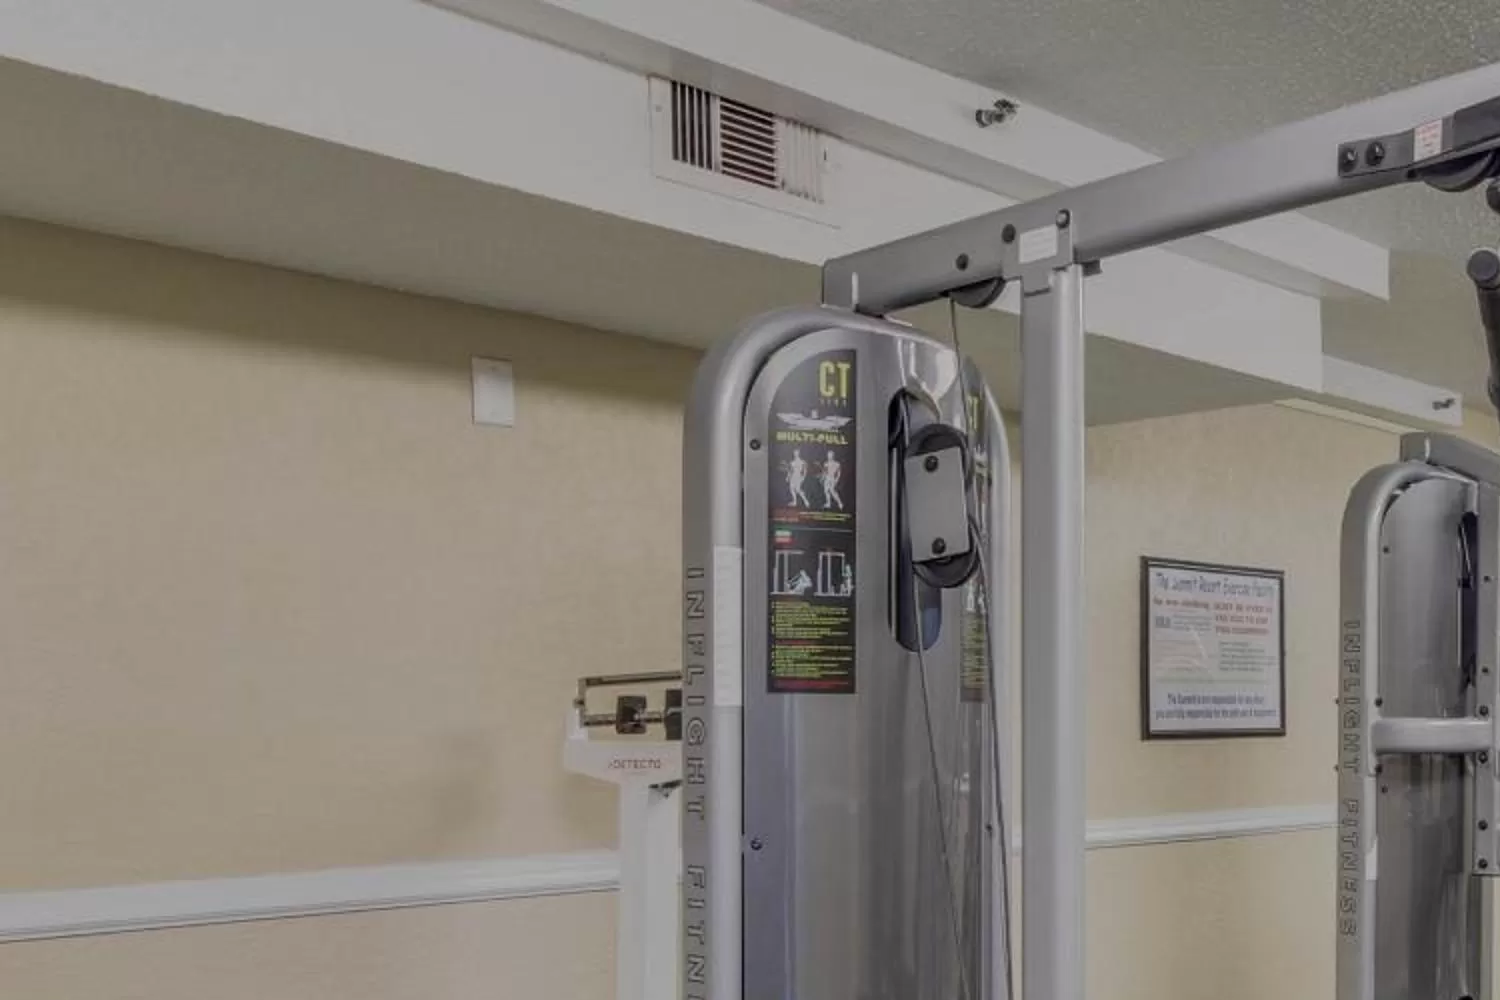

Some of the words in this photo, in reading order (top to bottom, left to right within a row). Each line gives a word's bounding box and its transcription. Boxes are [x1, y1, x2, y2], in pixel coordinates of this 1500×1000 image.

[819, 360, 851, 398] CT
[687, 567, 706, 821] INFLIGHT
[1339, 798, 1360, 937] FITNESS
